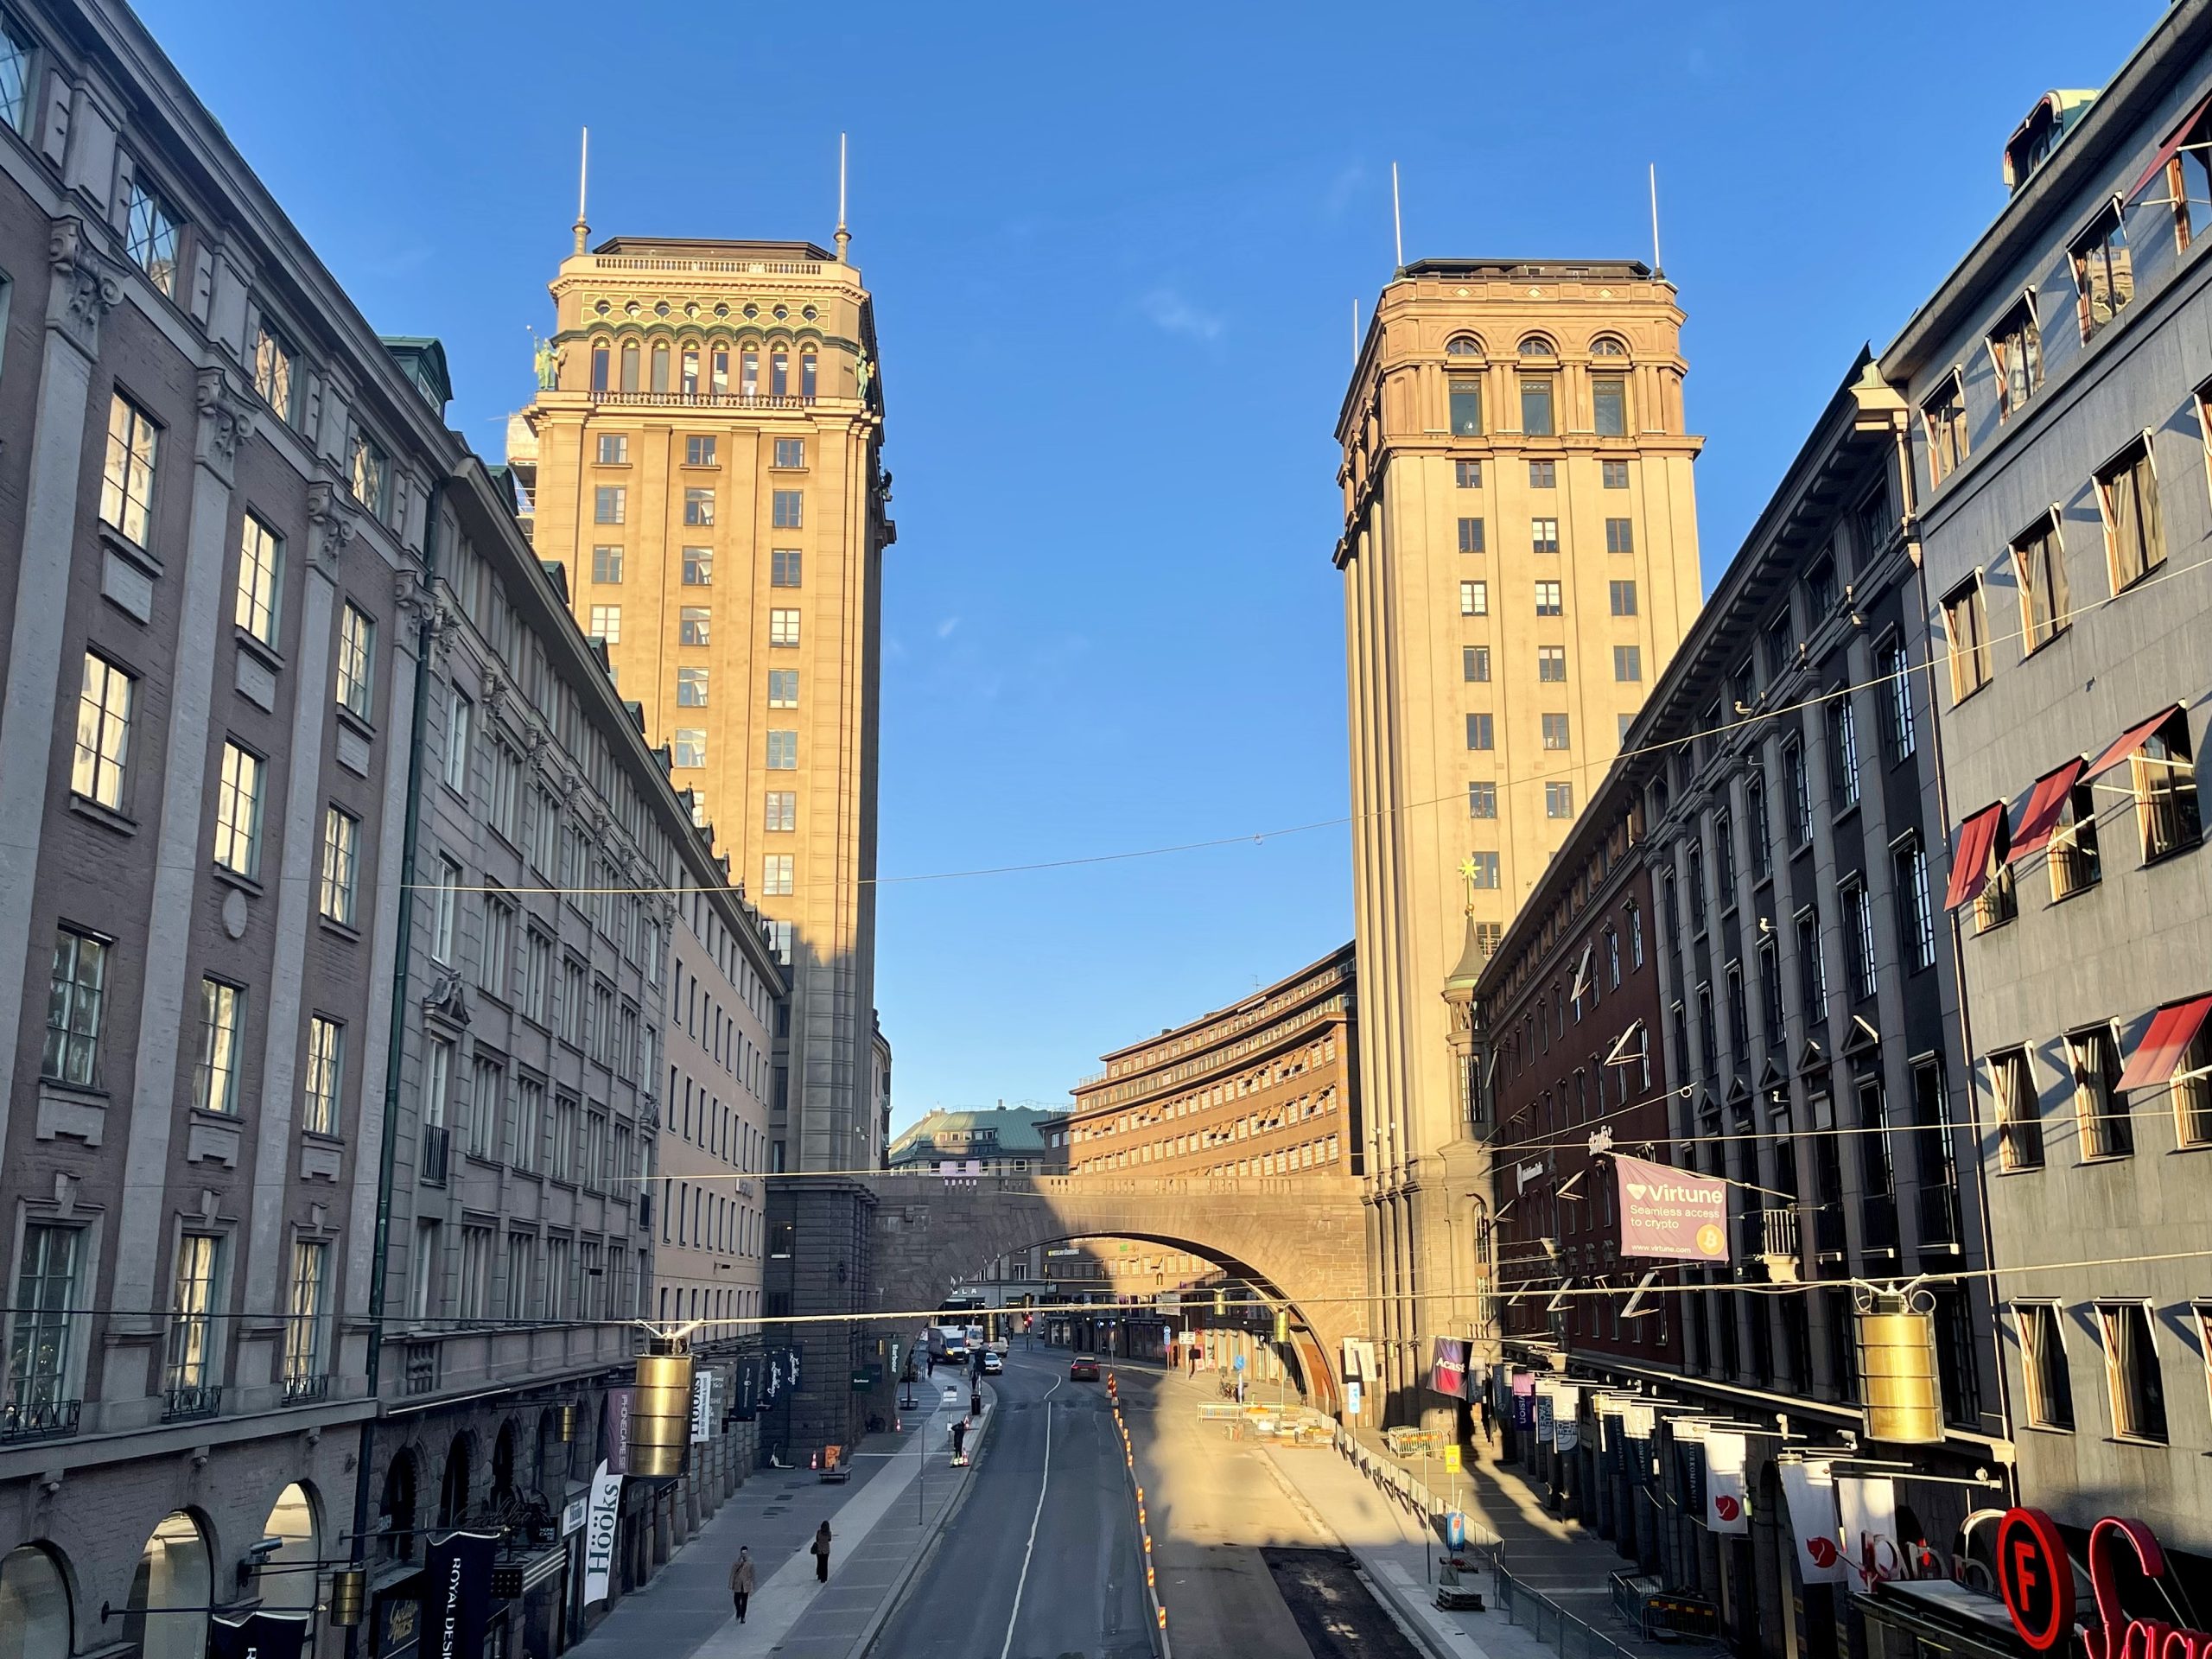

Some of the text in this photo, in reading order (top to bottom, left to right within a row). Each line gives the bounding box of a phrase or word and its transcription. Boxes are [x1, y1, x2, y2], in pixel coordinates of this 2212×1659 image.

[1649, 1184, 1723, 1205] Virtune
[1630, 1205, 1720, 1219] Seamless access
[1630, 1217, 1680, 1230] to crypto
[1631, 1243, 1692, 1254] www.virtune.com
[1435, 1357, 1465, 1373] Acast
[588, 1484, 620, 1577] Hööks
[2014, 1541, 2036, 1612] F
[442, 1558, 461, 1659] ROYAL DESI
